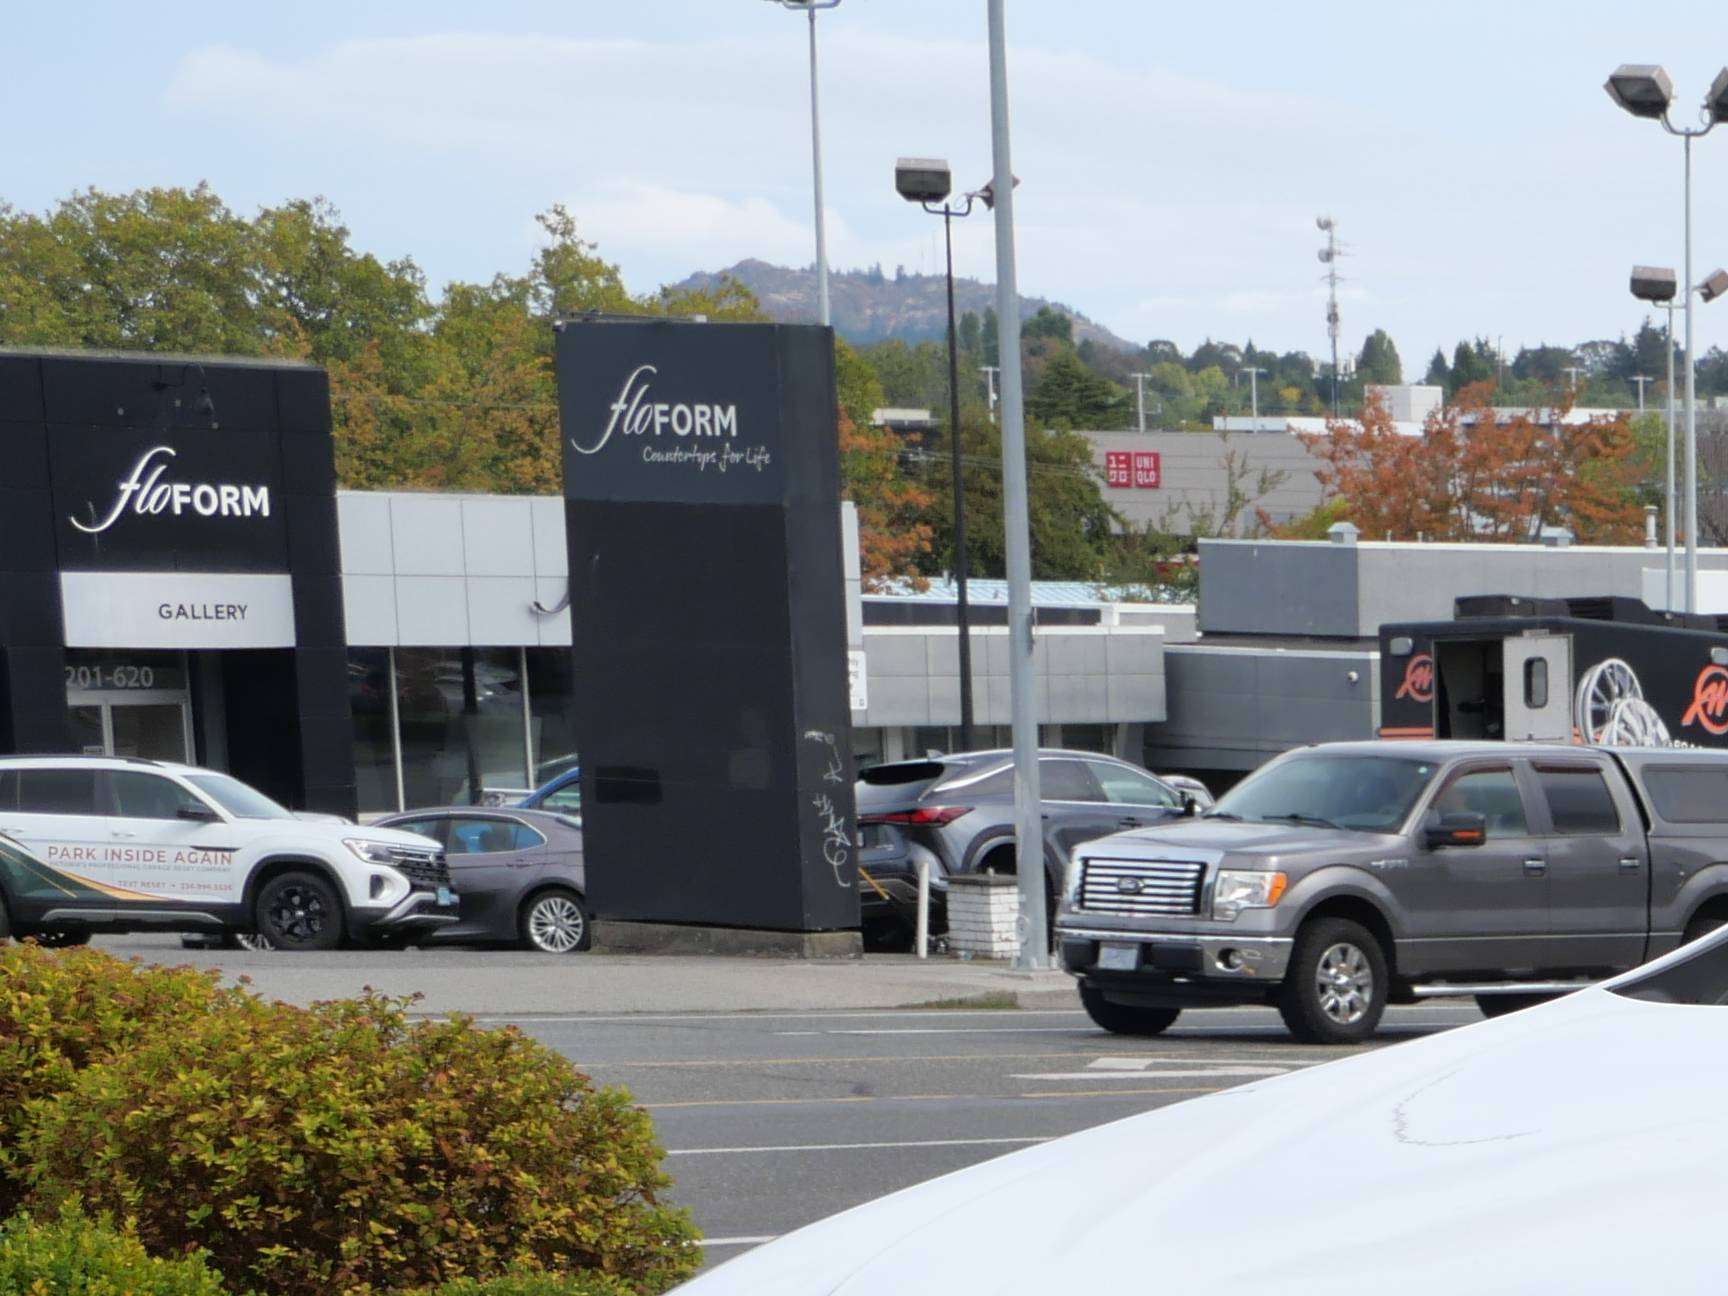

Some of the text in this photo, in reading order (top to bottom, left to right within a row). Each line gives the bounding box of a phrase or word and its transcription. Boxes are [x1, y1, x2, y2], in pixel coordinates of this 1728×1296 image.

[571, 364, 738, 455] floFORM
[643, 442, 771, 472] Countertops for Life
[1136, 455, 1154, 468] UNI
[1136, 470, 1156, 485] QLO
[70, 446, 270, 533] floFORM
[158, 603, 248, 620] GALLERY
[65, 666, 154, 688] 201-620
[48, 846, 232, 865] PARK INSIDE AGAIN
